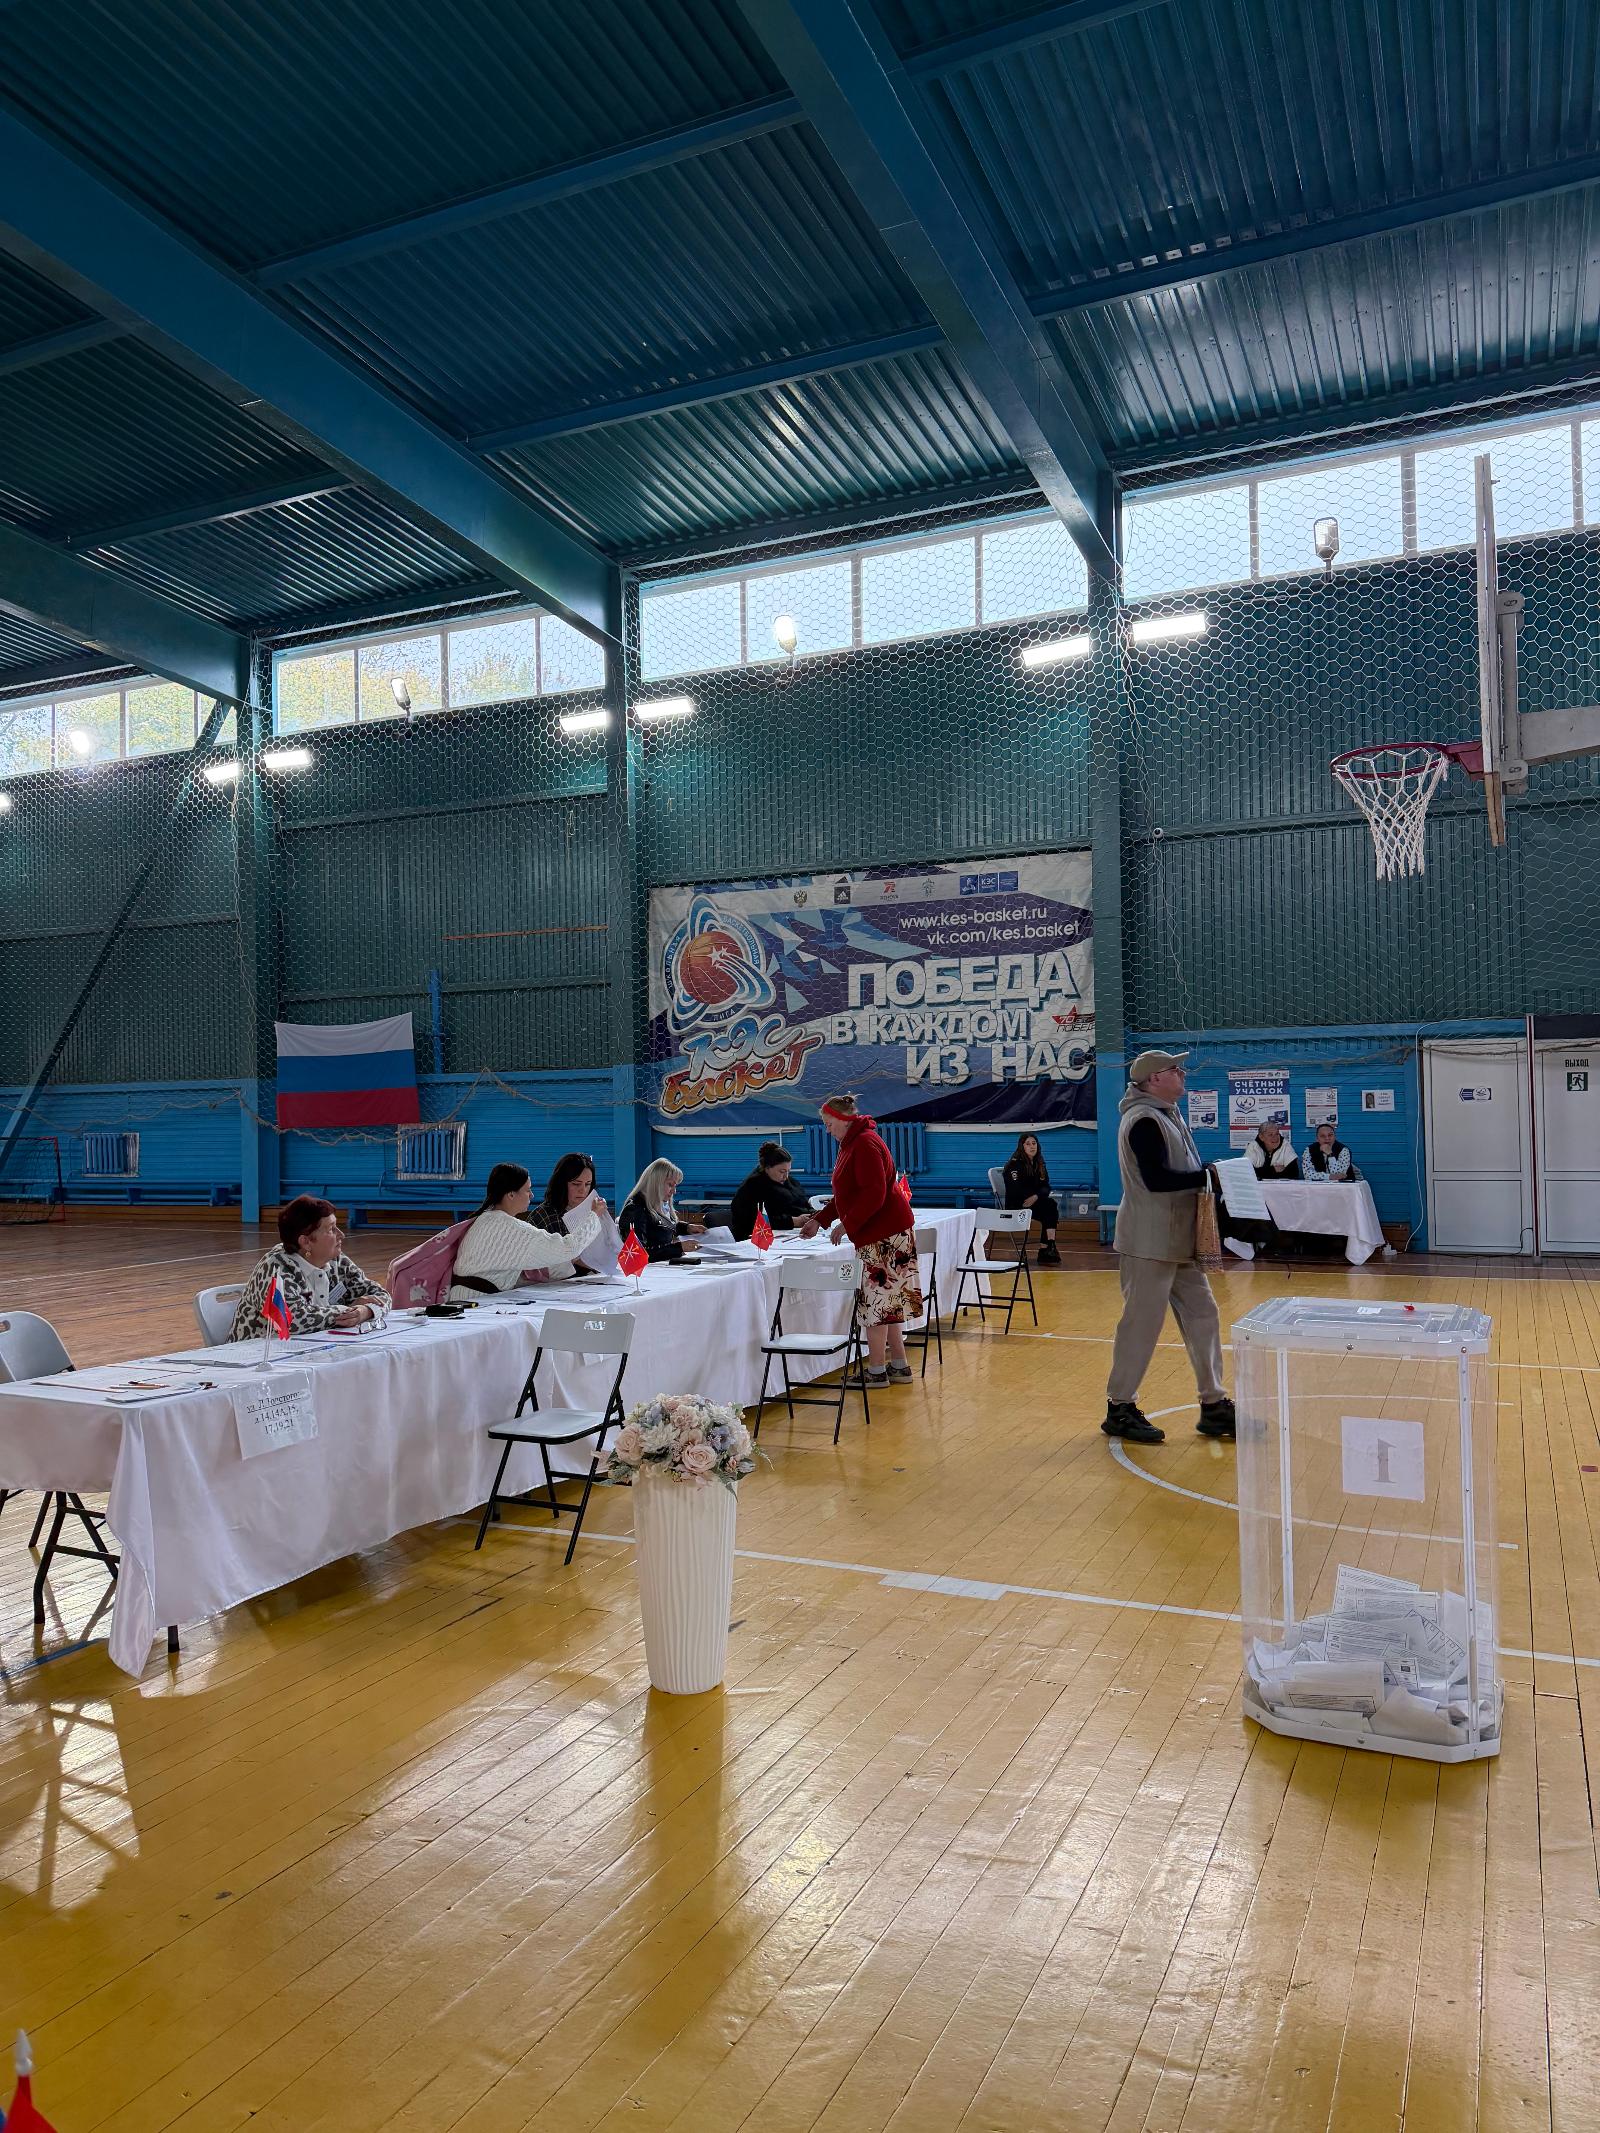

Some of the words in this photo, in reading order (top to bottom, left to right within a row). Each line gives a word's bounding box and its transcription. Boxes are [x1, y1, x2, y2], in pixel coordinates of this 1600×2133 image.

[981, 877, 996, 886] КЭС
[901, 906, 1047, 928] www.kes-basket.ru
[723, 916, 760, 966] БАСКЕТБОЛЬНАЯ
[928, 921, 1081, 945] vk.com/kes.basket
[664, 935, 682, 990] ШКОЛЬНАЯ
[848, 951, 1080, 1008] ПОБЕДА
[713, 1008, 736, 1021] ЛИГА
[831, 1016, 855, 1044] В
[868, 1008, 1030, 1046] КАЖДОМ
[907, 1044, 971, 1084] ИЗ
[991, 1039, 1092, 1083] НАС
[1565, 1059, 1589, 1067] ВЫХОД
[1234, 1079, 1284, 1088] СЧЁТНЫЙ
